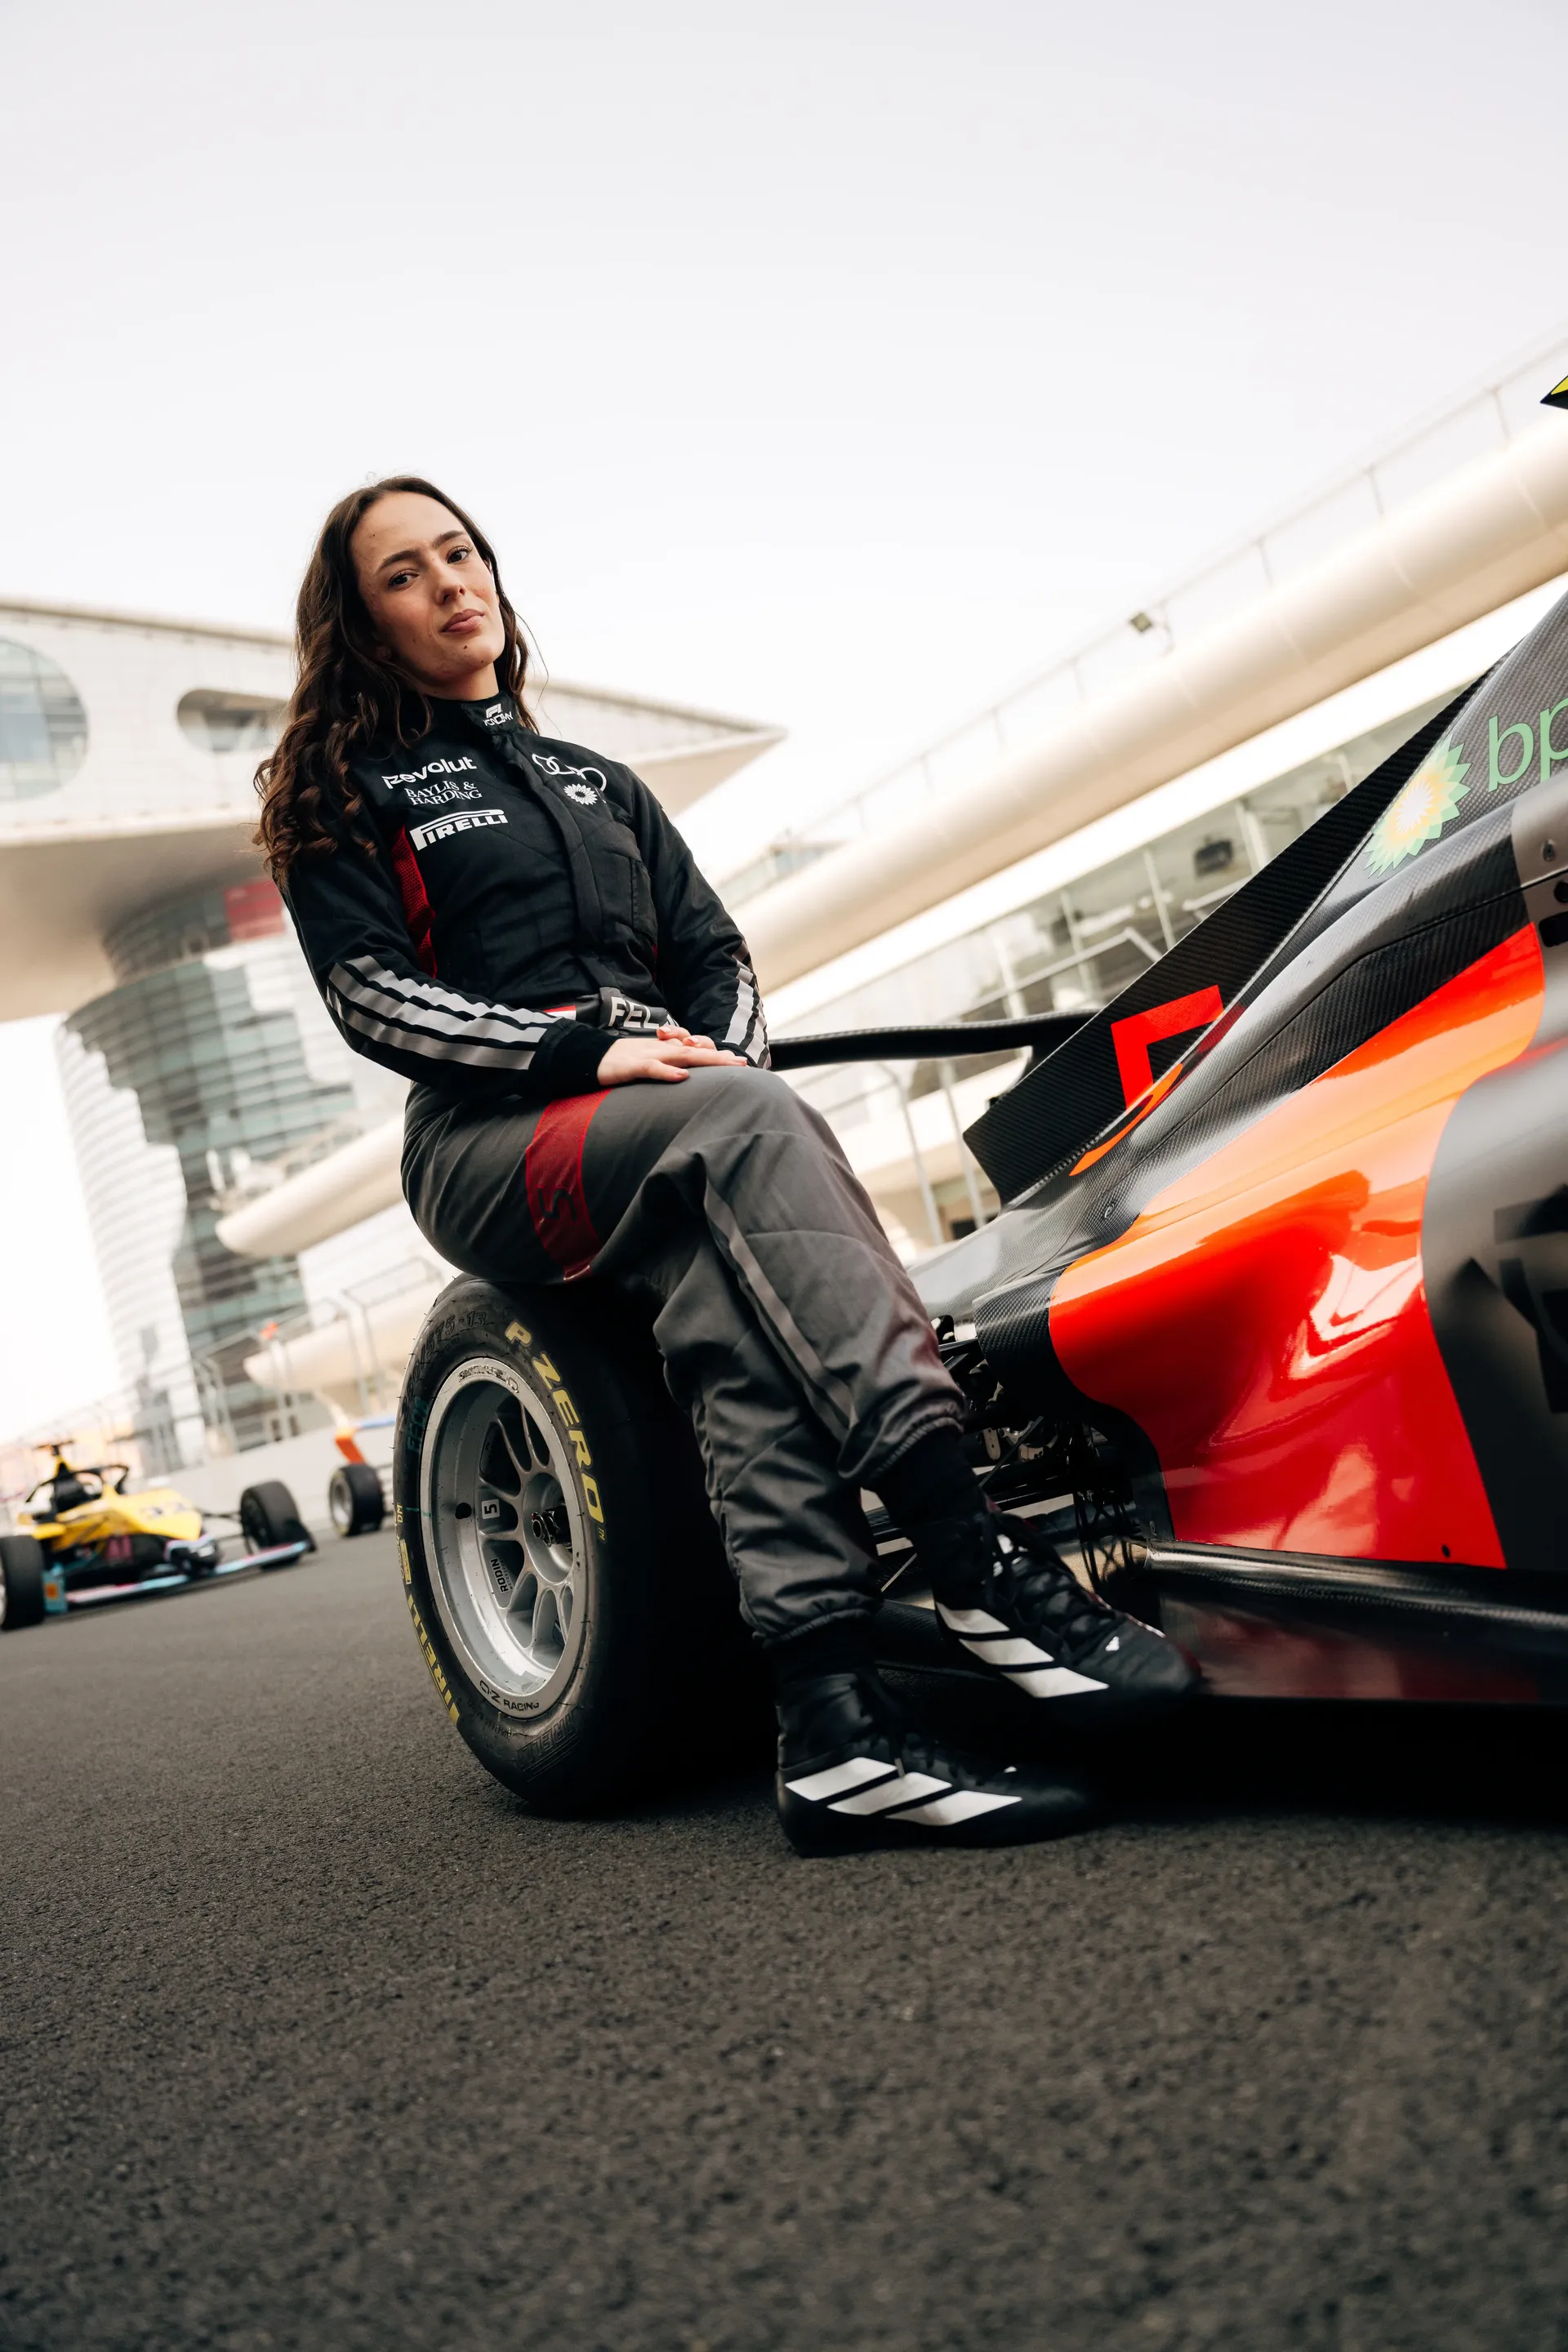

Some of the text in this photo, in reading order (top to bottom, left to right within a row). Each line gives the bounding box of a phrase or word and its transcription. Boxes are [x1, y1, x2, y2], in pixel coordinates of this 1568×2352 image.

[381, 756, 478, 789] Revolut
[404, 780, 477, 798] BAYLIS &
[408, 790, 483, 806] HARDING
[409, 808, 509, 852] PIRELLI
[505, 1319, 532, 1348] P
[532, 1352, 605, 1525] ZERO
[484, 1503, 498, 1515] 5
[490, 1558, 508, 1592] RODIN
